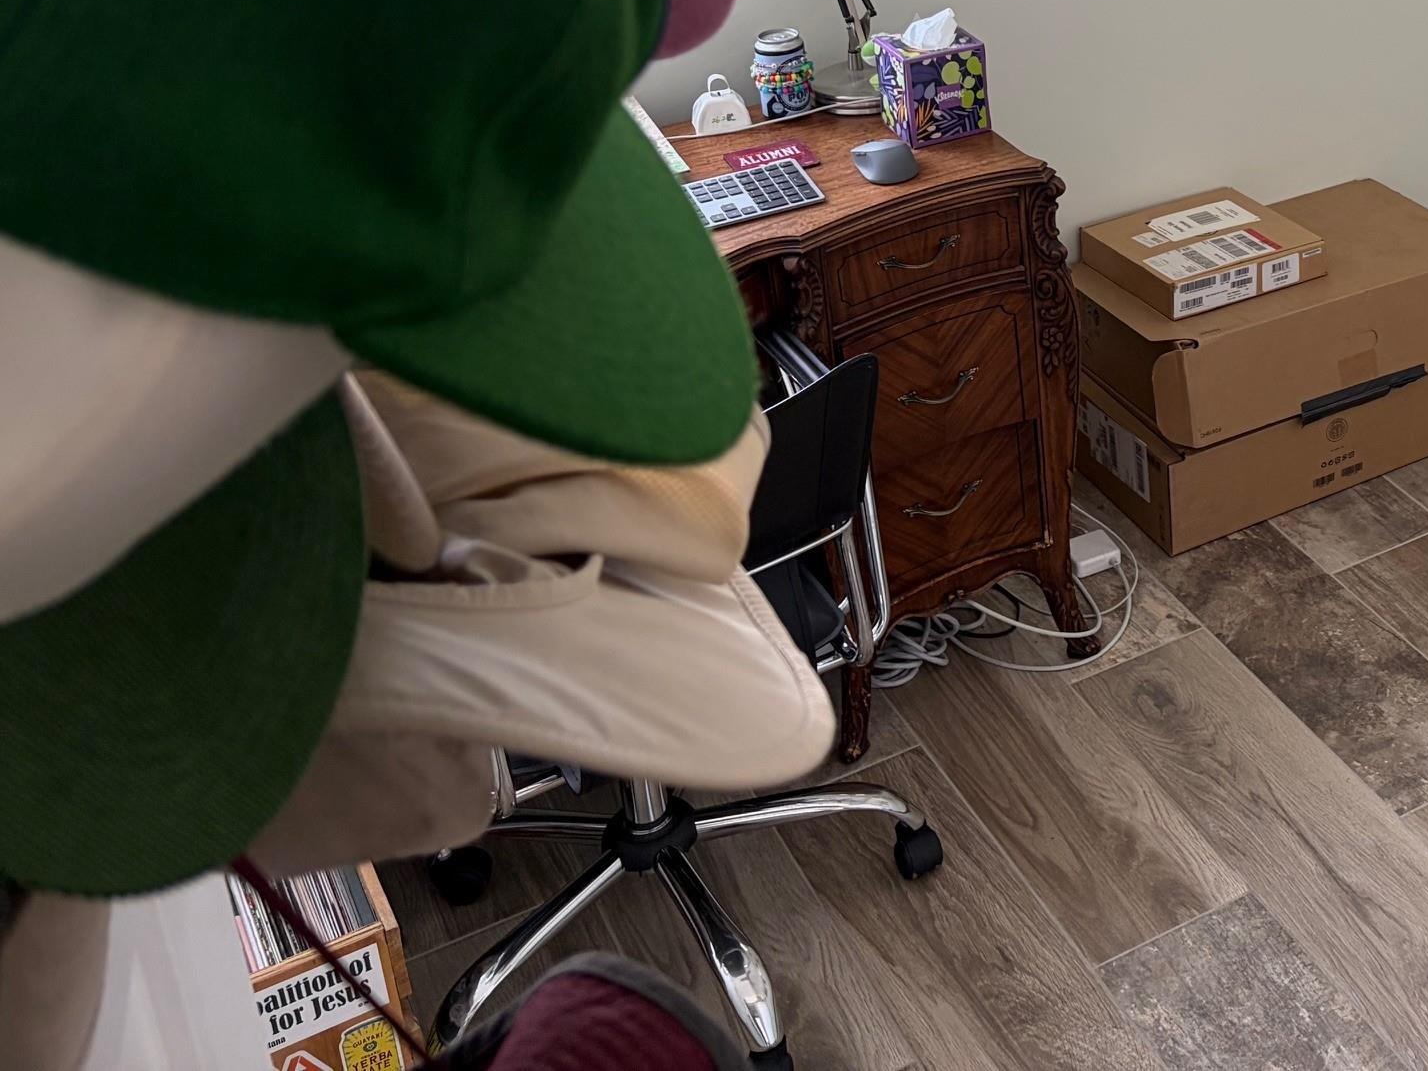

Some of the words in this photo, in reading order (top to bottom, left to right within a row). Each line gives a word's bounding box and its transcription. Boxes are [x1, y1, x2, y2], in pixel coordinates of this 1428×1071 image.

[739, 145, 801, 167] ALUMNI
[349, 951, 373, 977] of
[269, 1006, 304, 1035] for
[310, 979, 372, 1021] Jesus
[352, 1050, 393, 1071] YERBA
